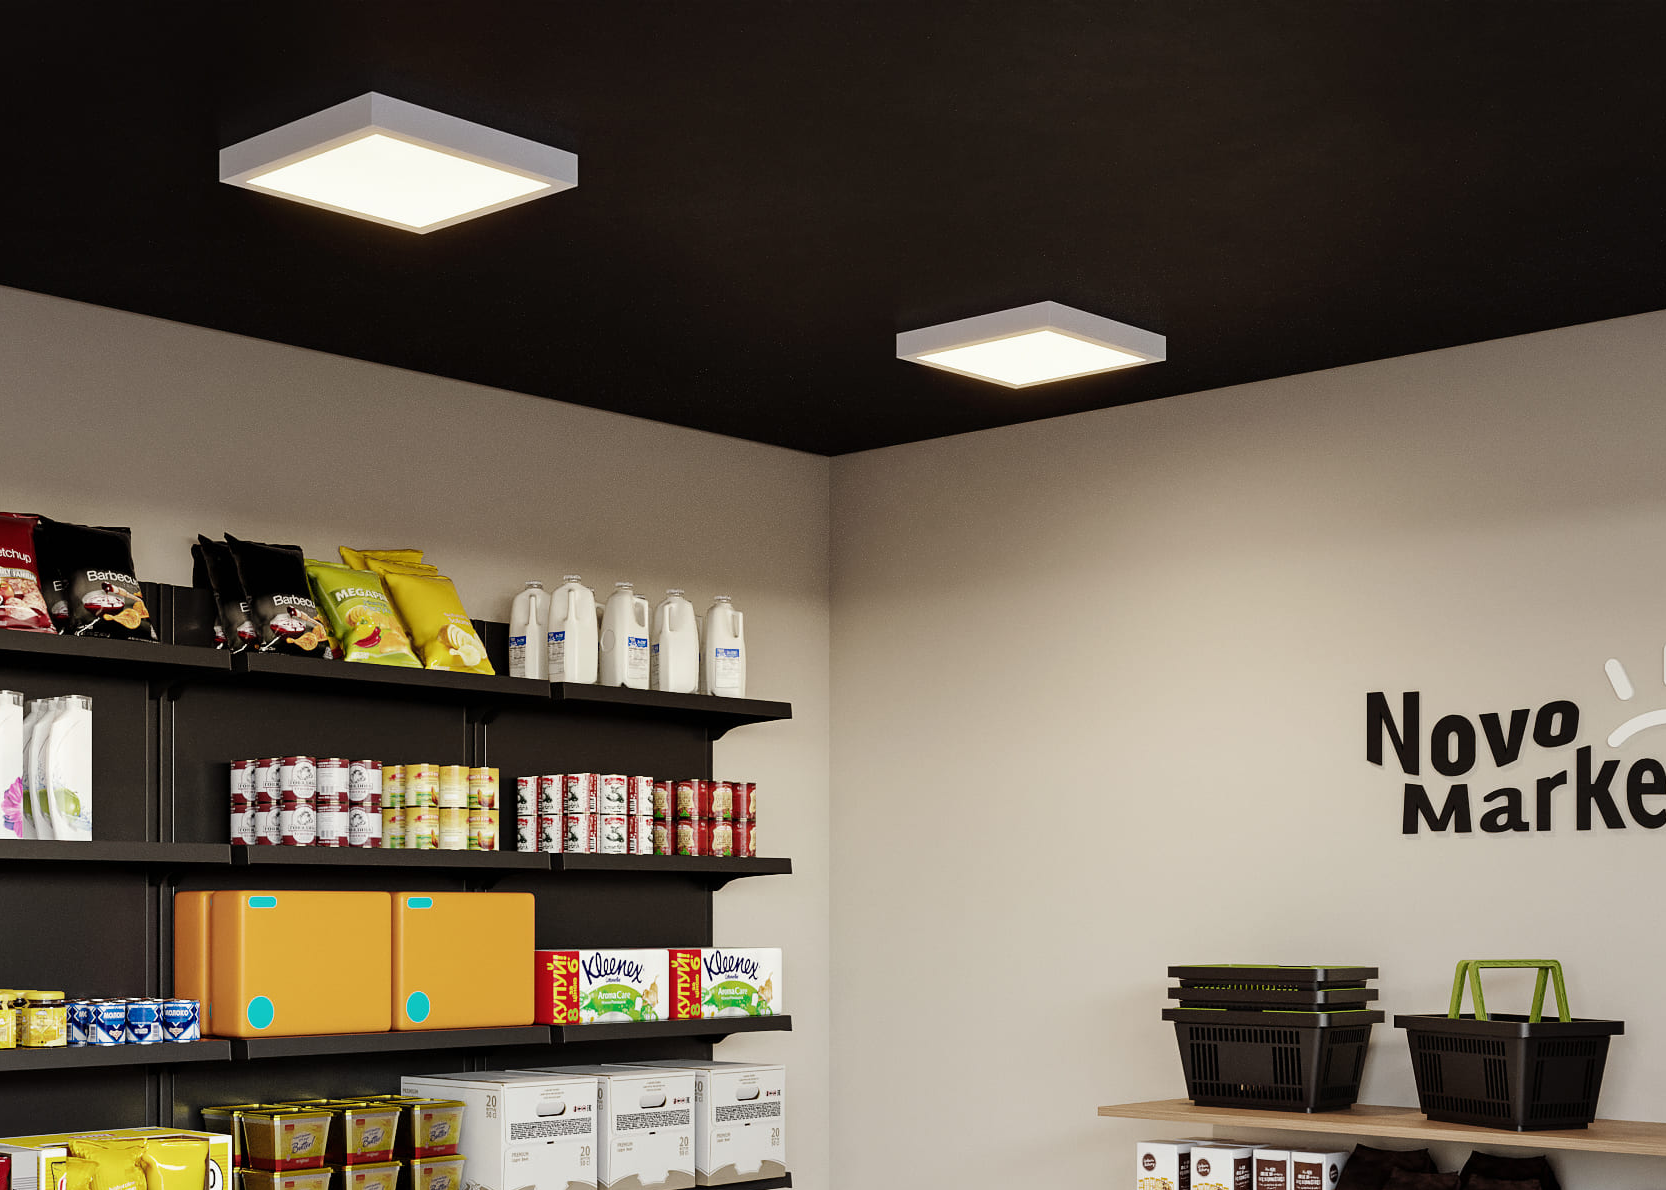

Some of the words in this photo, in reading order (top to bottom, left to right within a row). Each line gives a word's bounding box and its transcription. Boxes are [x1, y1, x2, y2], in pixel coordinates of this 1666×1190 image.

[86, 570, 137, 585] Barbecu
[273, 594, 316, 609] Barbecu
[1366, 691, 1580, 776] Novo
[567, 957, 579, 973] 6
[582, 952, 644, 985] Kleenex
[690, 954, 700, 970] 6
[703, 950, 759, 981] Kleenex
[547, 954, 567, 1024] КУПУЙ!
[671, 953, 690, 1018] КУПУЙ!
[567, 1008, 579, 1021] 8
[690, 1003, 700, 1016] 8
[486, 1095, 497, 1108] 20
[771, 1128, 780, 1138] 20
[679, 1136, 689, 1146] 20
[580, 1145, 590, 1156] 20
